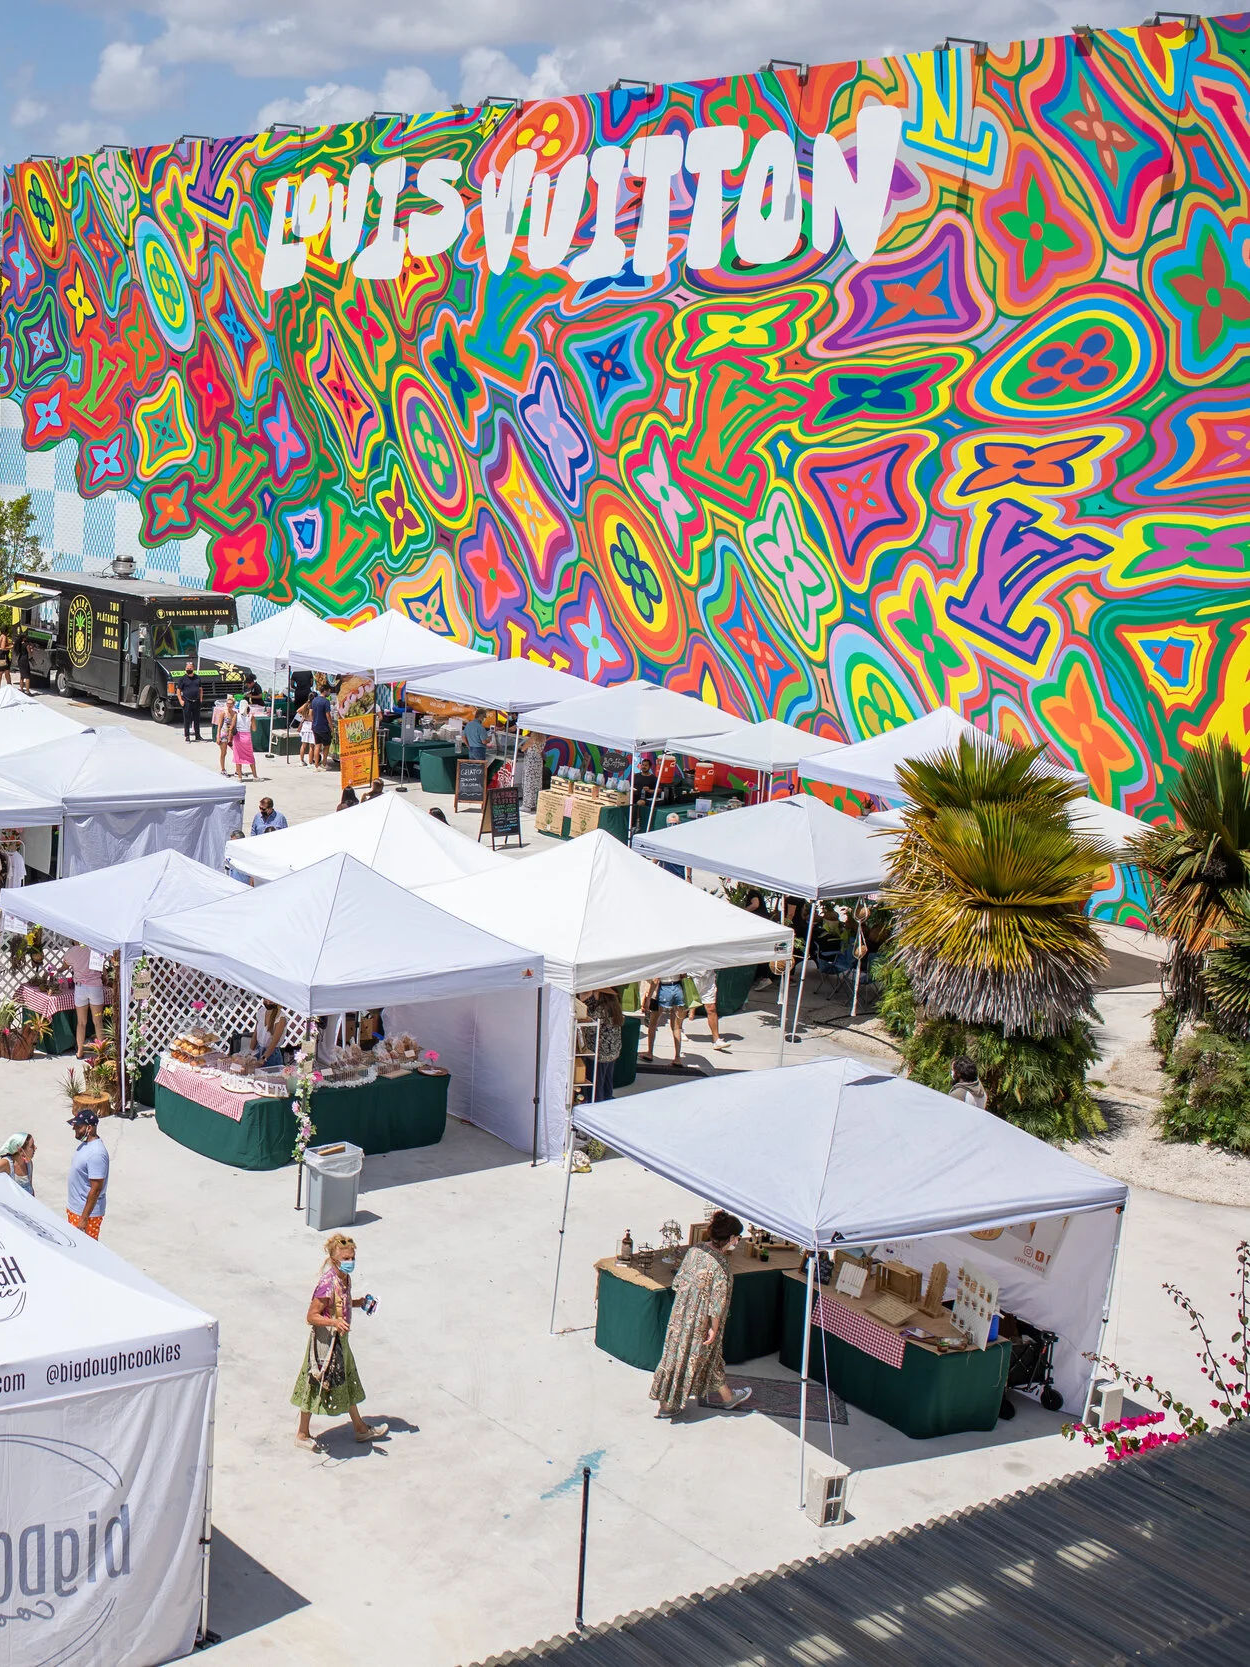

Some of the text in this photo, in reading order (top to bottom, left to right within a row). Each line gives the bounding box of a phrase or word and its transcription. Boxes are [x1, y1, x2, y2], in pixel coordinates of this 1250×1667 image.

[261, 105, 901, 291] LOUIS VUITTON
[110, 601, 120, 612] TWO
[45, 1342, 181, 1385] @bigdoughcookies
